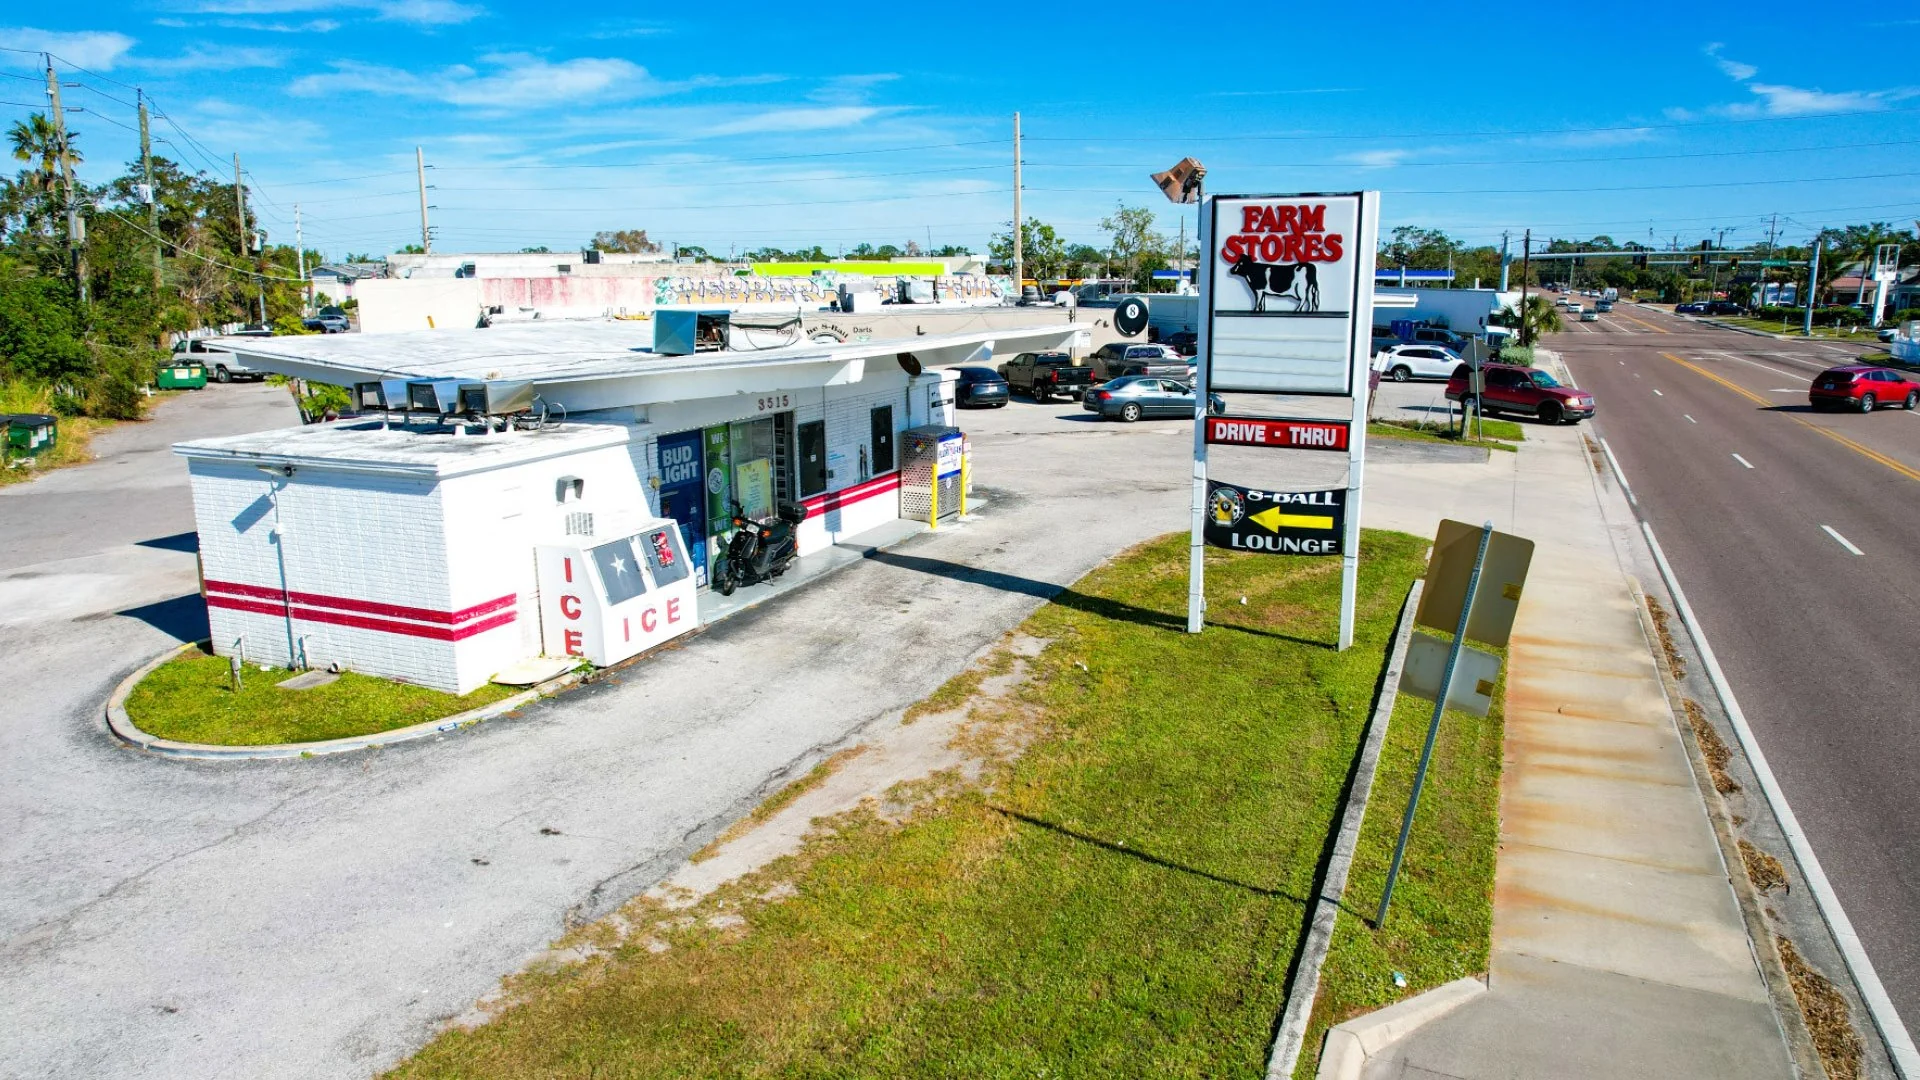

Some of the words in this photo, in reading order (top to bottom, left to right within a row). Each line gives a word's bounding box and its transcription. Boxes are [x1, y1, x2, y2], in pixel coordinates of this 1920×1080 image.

[1241, 204, 1327, 234] FARM
[1221, 234, 1344, 264] STORES
[1129, 306, 1136, 317] 8
[853, 326, 873, 334] Darts
[758, 395, 789, 411] 3515
[1215, 422, 1266, 443] DRIVE
[1289, 426, 1337, 447] THRU
[662, 445, 693, 467] BUD
[659, 460, 699, 484] LIGHT
[1246, 490, 1341, 506] 8-BALL
[1231, 532, 1338, 554] LOUNGE
[560, 557, 584, 657] ICE
[623, 597, 681, 642] ICE
